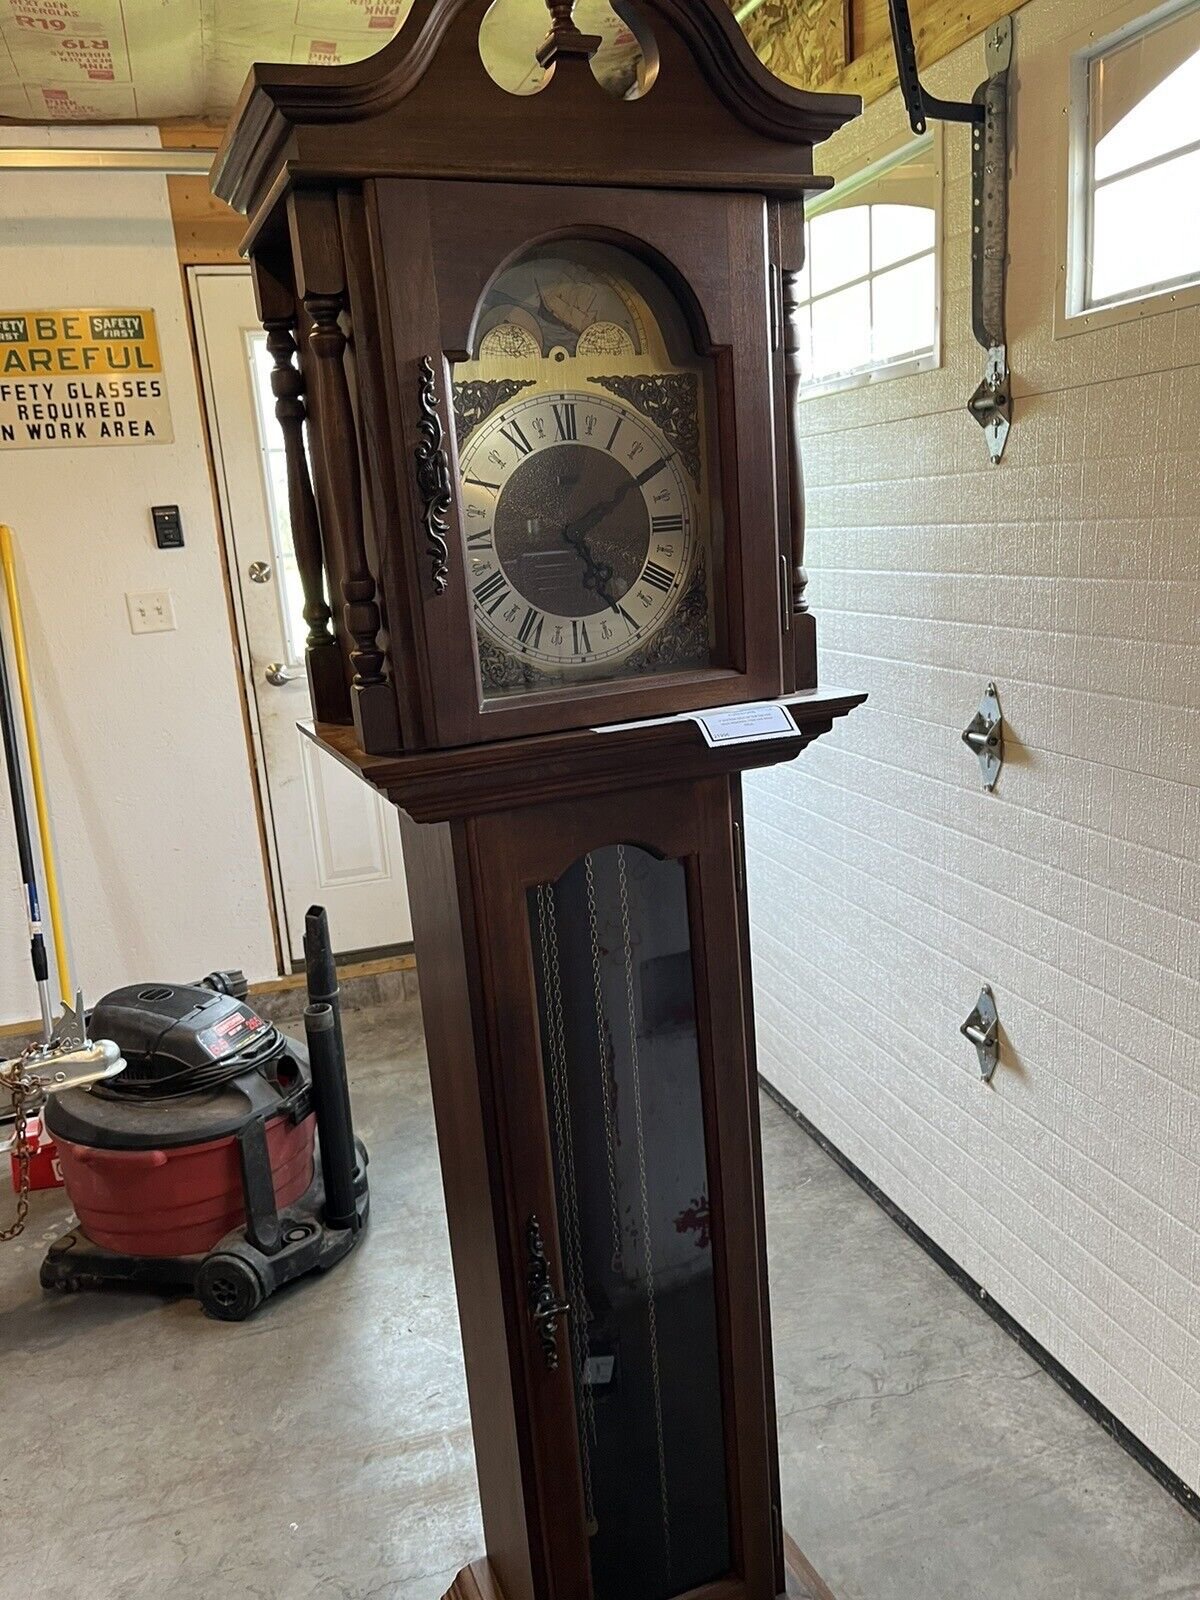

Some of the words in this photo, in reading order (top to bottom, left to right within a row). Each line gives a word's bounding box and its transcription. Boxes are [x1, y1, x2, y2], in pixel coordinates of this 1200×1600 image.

[364, 6, 400, 15] PINK
[15, 15, 66, 31] R19
[62, 40, 109, 50] R19
[309, 53, 341, 62] PINK
[45, 99, 77, 107] PINK
[35, 317, 82, 340] BE
[92, 317, 140, 332] SAFETY
[103, 329, 135, 338] FIRST
[3, 346, 154, 373] AREFUL
[0, 383, 53, 401] FETY
[67, 381, 162, 399] GLASSES
[17, 401, 126, 422] REQUIRED
[550, 403, 580, 442] XII
[1, 424, 15, 441] N
[27, 422, 87, 440] WORK
[100, 420, 156, 438] AREA
[497, 417, 537, 462] XI
[605, 415, 626, 453] I
[463, 467, 502, 501] X
[650, 514, 684, 536] III
[639, 558, 678, 594] IIII
[471, 568, 512, 617] VIII
[516, 605, 545, 649] VII
[570, 619, 593, 655] VI
